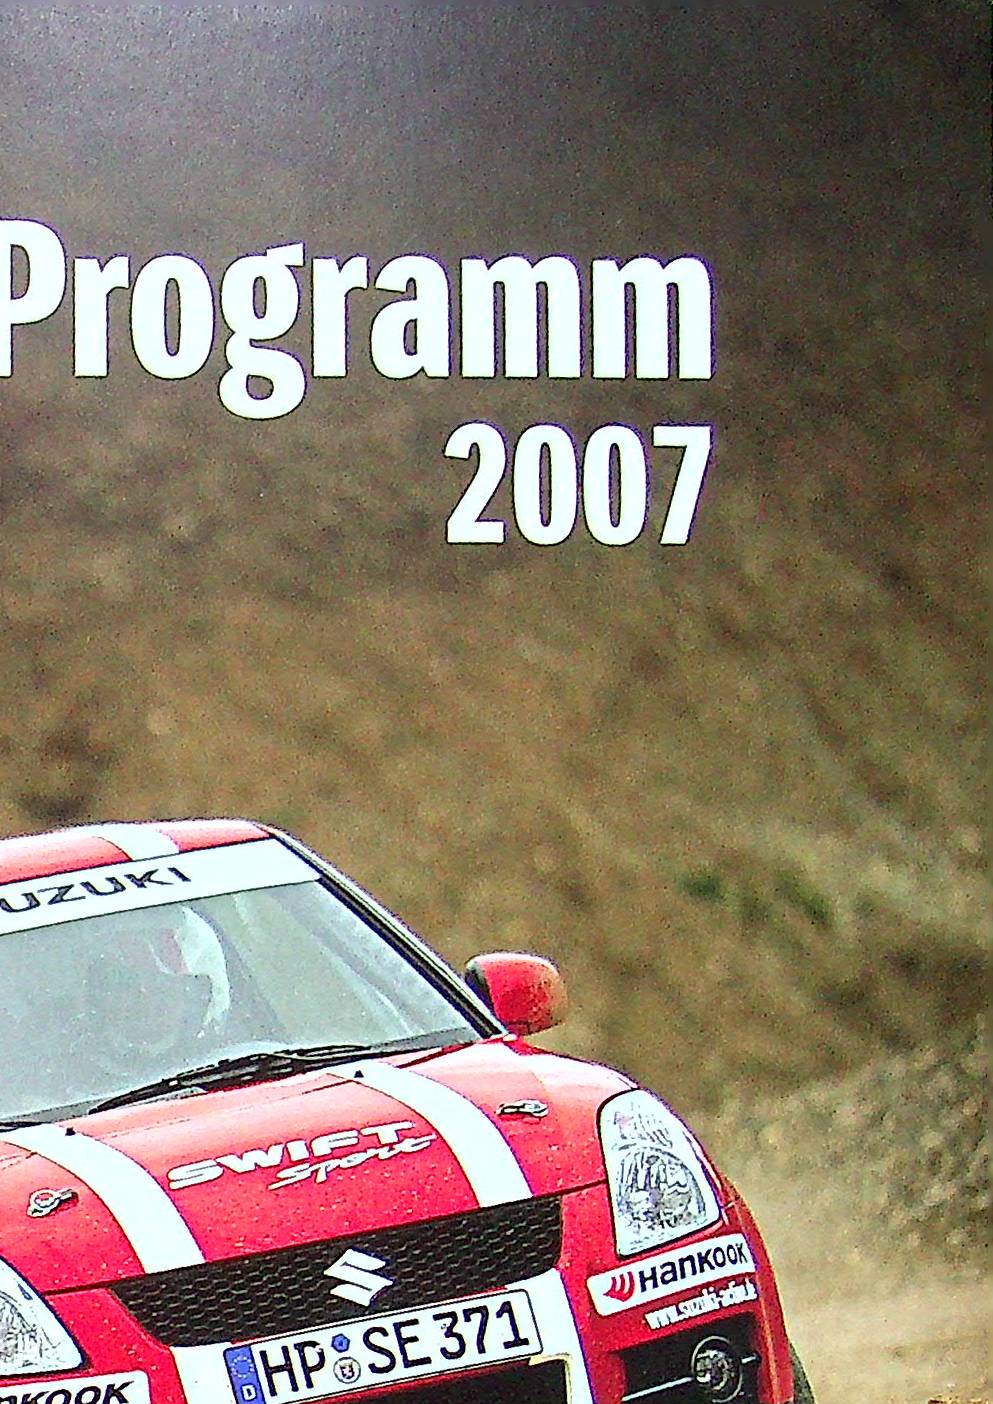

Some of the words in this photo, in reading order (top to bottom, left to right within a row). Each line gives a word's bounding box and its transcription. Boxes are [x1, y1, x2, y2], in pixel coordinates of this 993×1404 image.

[444, 422, 713, 547] 2007
[167, 1120, 416, 1190] SWIFT
[267, 1132, 437, 1190] Sport
[241, 1385, 257, 1401] D
[260, 1340, 325, 1397] HP
